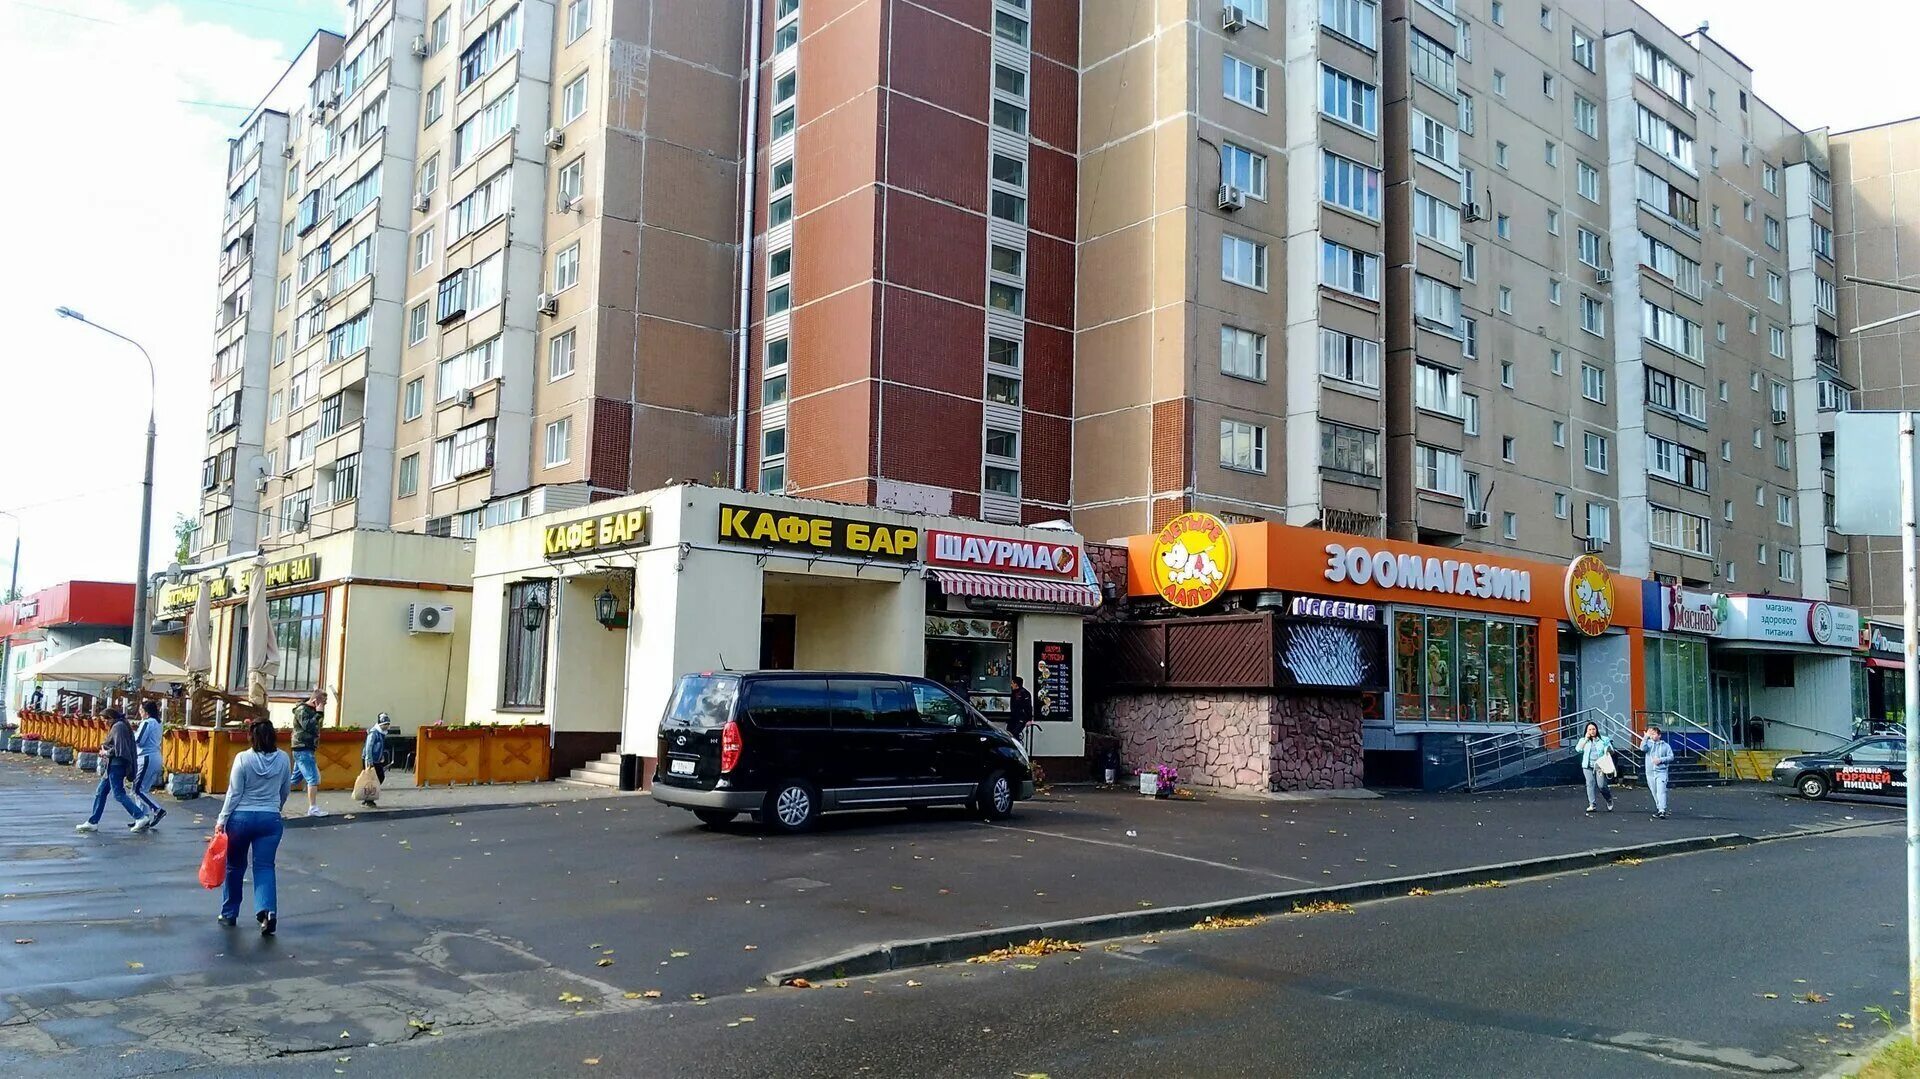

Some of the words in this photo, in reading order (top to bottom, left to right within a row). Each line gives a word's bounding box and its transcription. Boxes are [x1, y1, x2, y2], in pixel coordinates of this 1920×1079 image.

[544, 520, 596, 555] КАФЕ
[600, 511, 644, 545] БАР
[721, 508, 832, 548] КАФЕ
[847, 523, 918, 555] БАР
[1160, 515, 1222, 545] ЧЕТЫРЕ
[935, 533, 1054, 571] ШАУРМА
[291, 557, 310, 581] ЗАЛ
[1324, 543, 1531, 603] ЗООМАГАЗИН
[1163, 579, 1219, 607] ЛАПЫ
[1761, 615, 1797, 626] здорового
[1765, 604, 1793, 613] магазин
[1765, 628, 1793, 637] питания
[1835, 771, 1891, 784] ГОРЯЧЕЙ
[1842, 766, 1883, 774] ДОСТАВКА
[1843, 781, 1883, 790] ПИЦЦЫ
